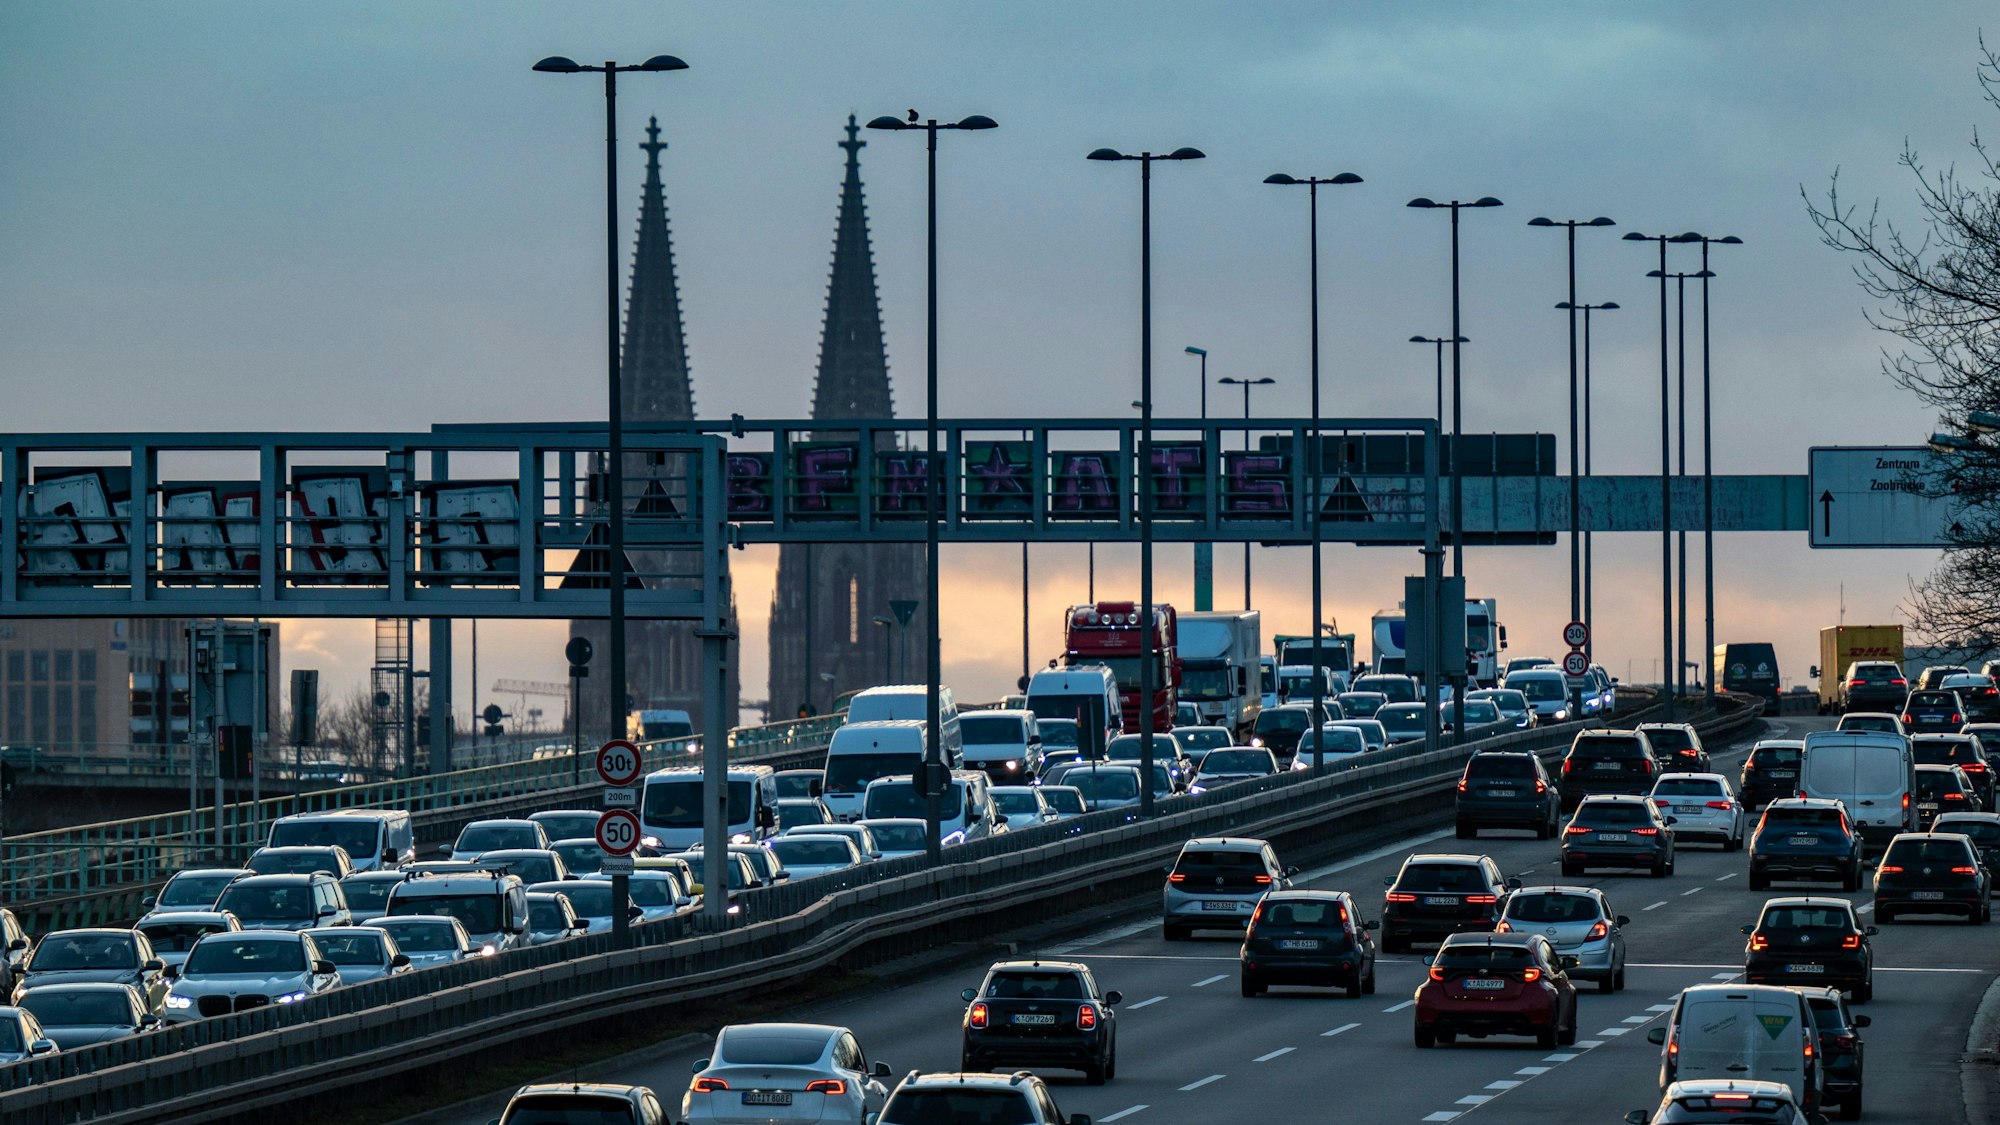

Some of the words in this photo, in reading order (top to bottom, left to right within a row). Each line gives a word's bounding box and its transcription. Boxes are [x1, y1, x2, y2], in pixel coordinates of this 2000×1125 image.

[1875, 457, 1919, 469] Zentrum
[1849, 647, 1889, 657] DHL
[1569, 658, 1584, 670] 50
[604, 755, 632, 772] 30t
[607, 822, 631, 843] 50
[1763, 1016, 1784, 1025] WM
